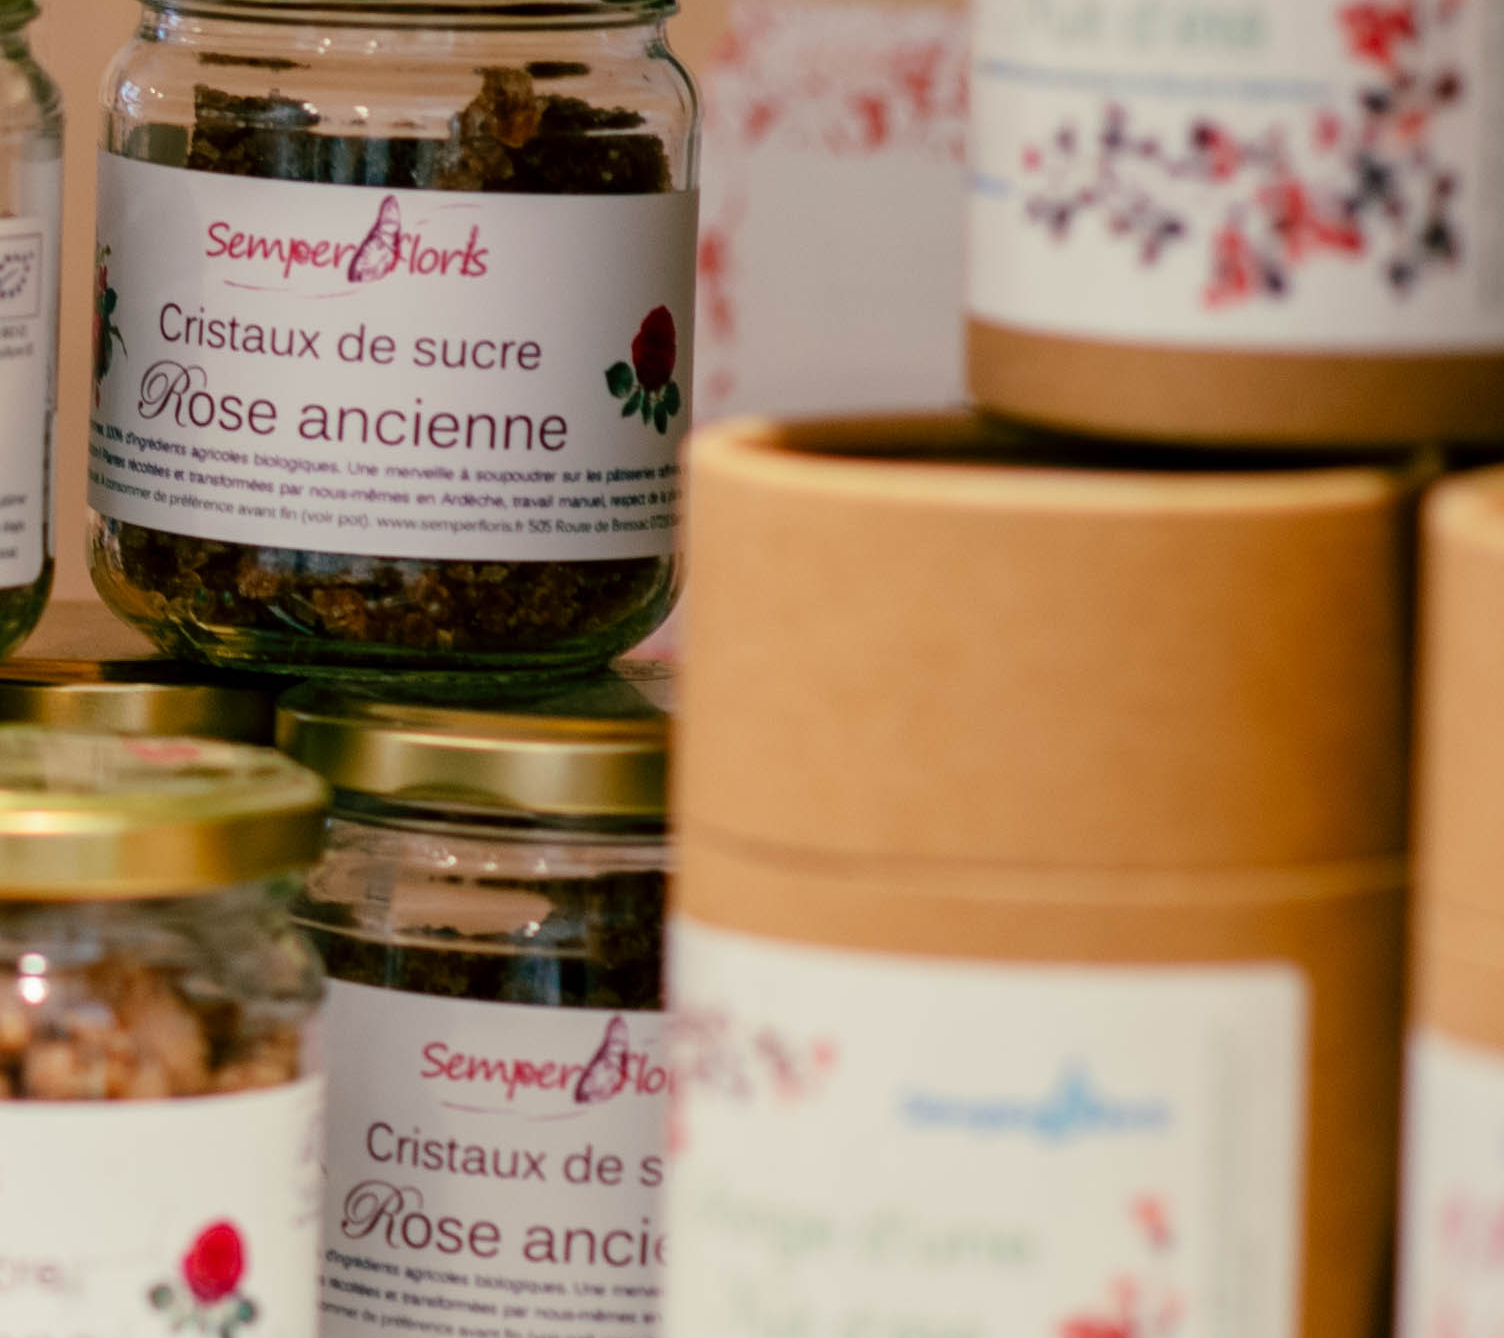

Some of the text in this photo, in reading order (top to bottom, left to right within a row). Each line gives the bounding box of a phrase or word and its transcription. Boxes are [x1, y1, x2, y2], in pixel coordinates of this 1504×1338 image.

[205, 213, 489, 286] Semperfloris
[159, 302, 543, 372] Cristaux de sucre
[137, 359, 568, 451] Rose ancienne
[126, 427, 186, 457] d'ingrédients
[191, 443, 248, 465] agricoles
[254, 452, 340, 476] biologiques.
[347, 461, 379, 477] Une
[386, 464, 455, 480] merveille
[562, 470, 581, 483] sur
[170, 493, 234, 514] préférence
[239, 504, 276, 519] avant
[280, 507, 298, 521] fin
[302, 510, 334, 525] (voir
[557, 519, 592, 534] Route
[595, 518, 609, 533] de
[174, 469, 185, 482] et
[189, 471, 274, 494] transformées
[280, 482, 303, 499] par
[310, 485, 409, 505] nous-mêmes
[416, 492, 436, 506] en
[442, 491, 507, 510] Ardèche,
[513, 492, 555, 509] travail
[366, 1122, 546, 1182] Cristaux
[564, 1144, 622, 1187] de
[341, 1180, 500, 1260] Rose
